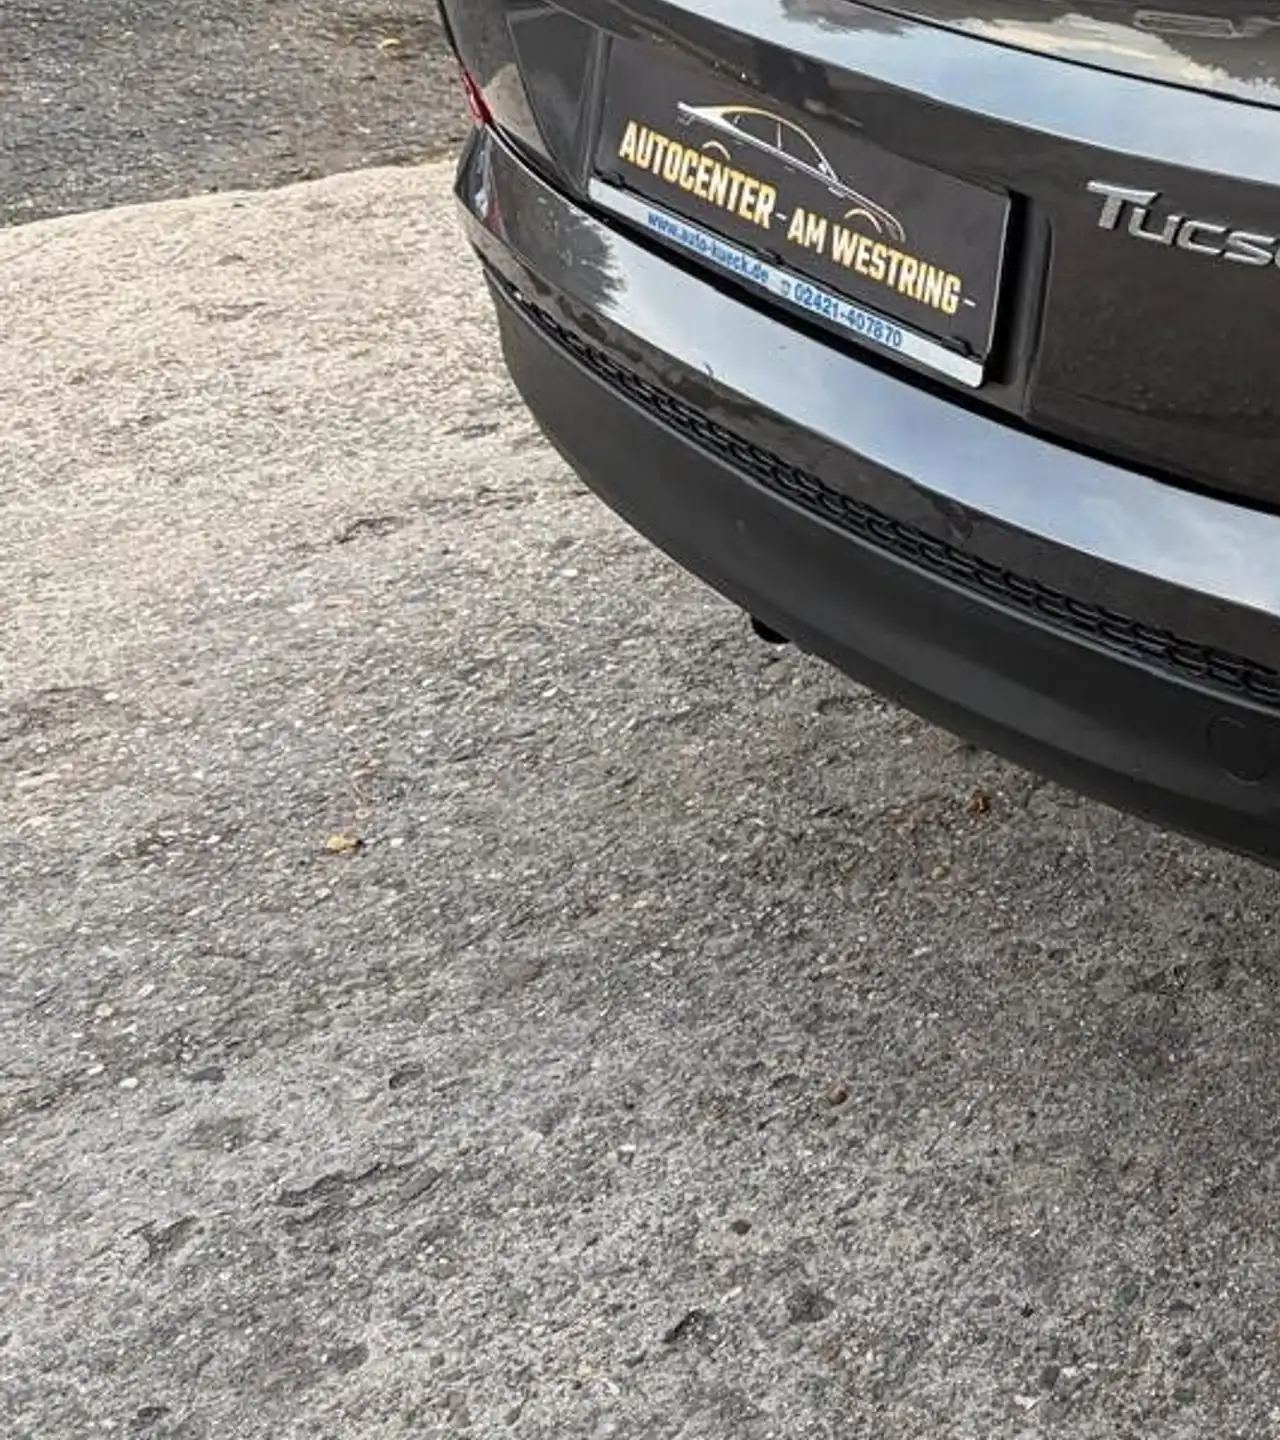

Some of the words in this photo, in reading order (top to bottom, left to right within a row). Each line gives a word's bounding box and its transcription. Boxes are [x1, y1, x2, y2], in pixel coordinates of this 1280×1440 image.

[618, 119, 777, 230] AUTOCENTER
[787, 206, 828, 255] AM
[831, 223, 962, 315] WESTRING
